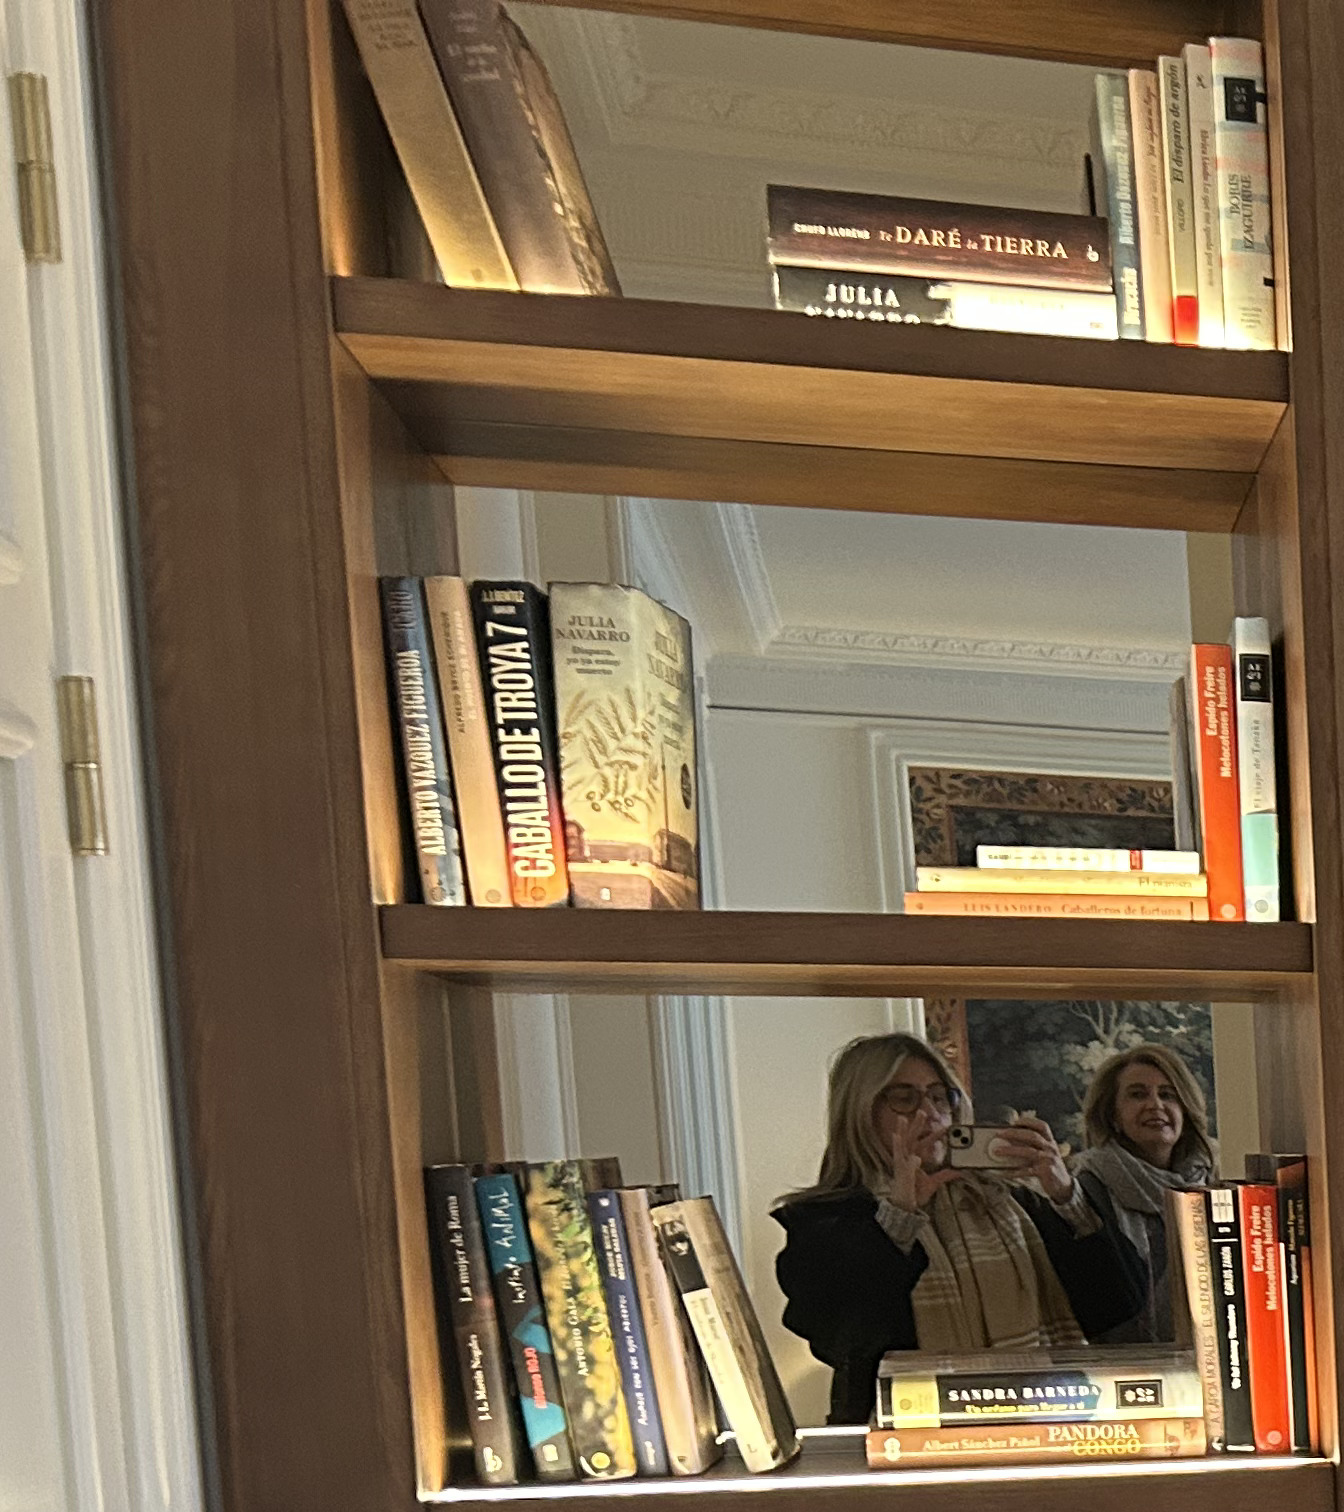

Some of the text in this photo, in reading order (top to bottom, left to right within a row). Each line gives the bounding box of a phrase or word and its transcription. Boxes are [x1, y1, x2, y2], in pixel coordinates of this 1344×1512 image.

[1167, 64, 1185, 183] El disparo de argón
[1228, 174, 1240, 215] BORIS
[1241, 175, 1255, 250] IZAGUIRRE
[895, 226, 962, 250] DARÉ
[980, 234, 1069, 260] TIERRA
[824, 282, 901, 309] JULIA
[485, 621, 528, 638] 7
[555, 628, 631, 642] NAVARRO
[568, 615, 616, 629] JULIA
[396, 650, 429, 719] FIGUEROA
[488, 639, 538, 724] TROYA
[1204, 666, 1218, 736] Espido Freire
[1217, 666, 1232, 777] Melocotones helados
[498, 727, 544, 761] DE
[416, 790, 447, 856] ALBERTO
[502, 764, 556, 878] CABALLO
[996, 902, 1052, 914] LANDERO
[1061, 902, 1121, 915] Caballeros
[1124, 904, 1138, 915] de
[1140, 905, 1183, 917] fortuna
[447, 1195, 473, 1303] La mujer de Roma
[1249, 1205, 1264, 1272] Espido Freire
[1196, 1261, 1209, 1273] DE
[1262, 1205, 1278, 1310] Melocotones helados
[1198, 1274, 1213, 1317] SILENCIO
[1222, 1269, 1236, 1296] CARLOS
[523, 1346, 541, 1374] ROJO
[1203, 1335, 1216, 1379] MORALES
[948, 1383, 1100, 1402] SANDRA BARNEDA
[923, 1435, 1041, 1452] Albert Sánchez Piñol
[1047, 1424, 1140, 1443] PANDORA
[1073, 1438, 1142, 1456] CONGO
